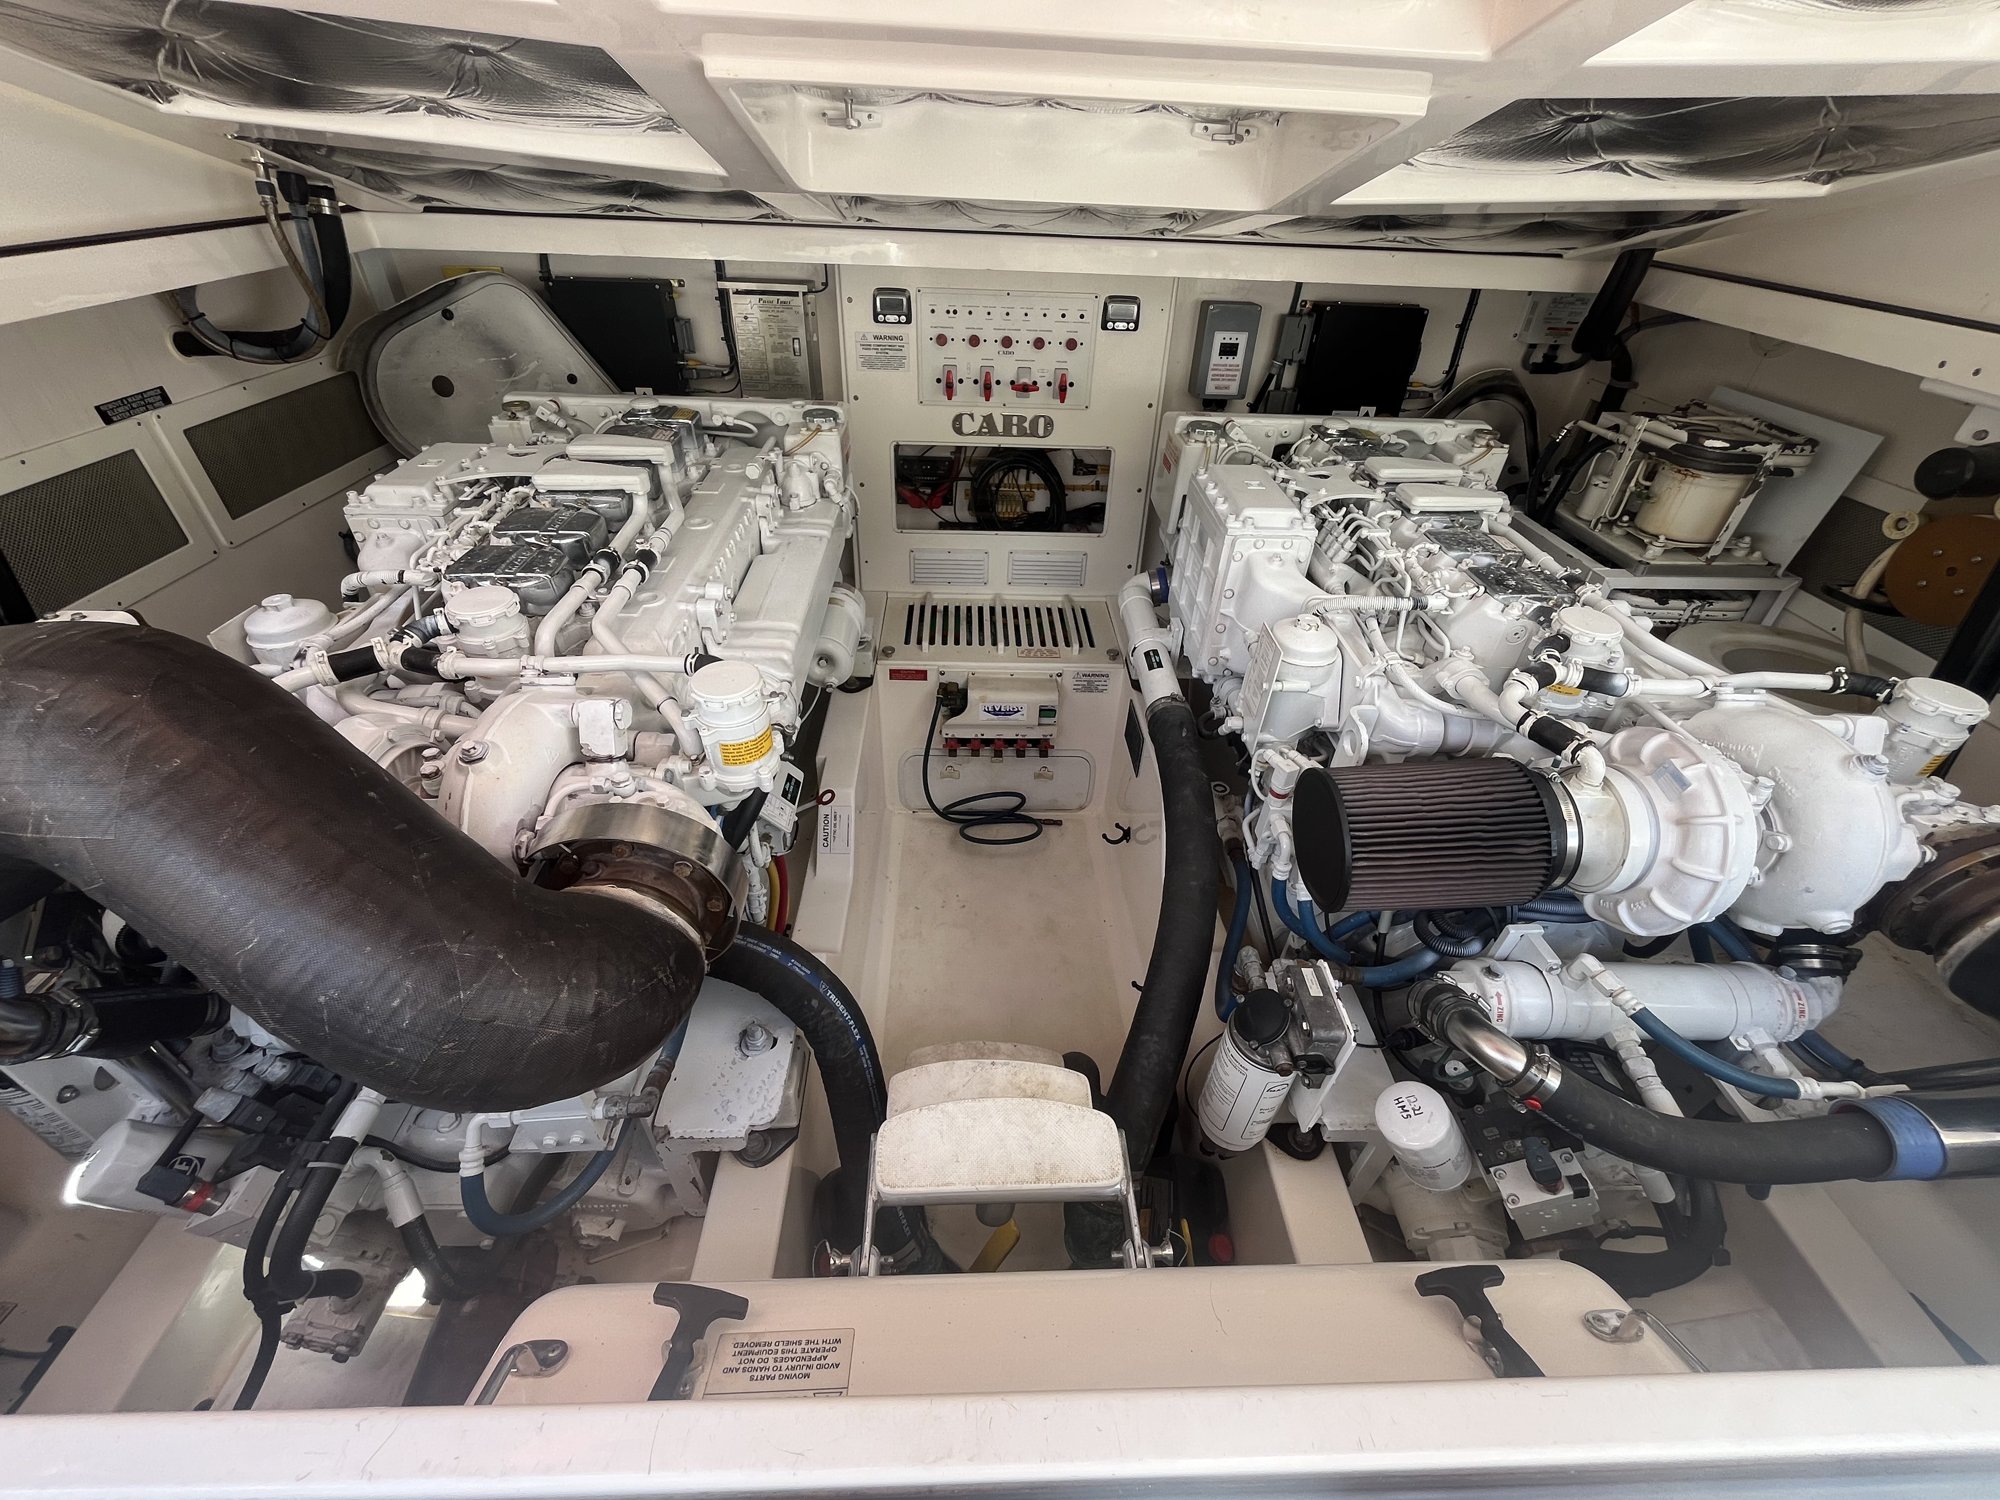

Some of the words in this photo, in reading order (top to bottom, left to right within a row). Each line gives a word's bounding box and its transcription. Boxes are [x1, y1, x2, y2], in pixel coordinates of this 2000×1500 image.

[952, 412, 1054, 438] CABO
[826, 989, 862, 1041] TRIDENT-FLEX
[1393, 1097, 1412, 1120] HMS
[732, 1348, 778, 1356] EQUIPMENT
[771, 1354, 828, 1363] APPENDAGES.
